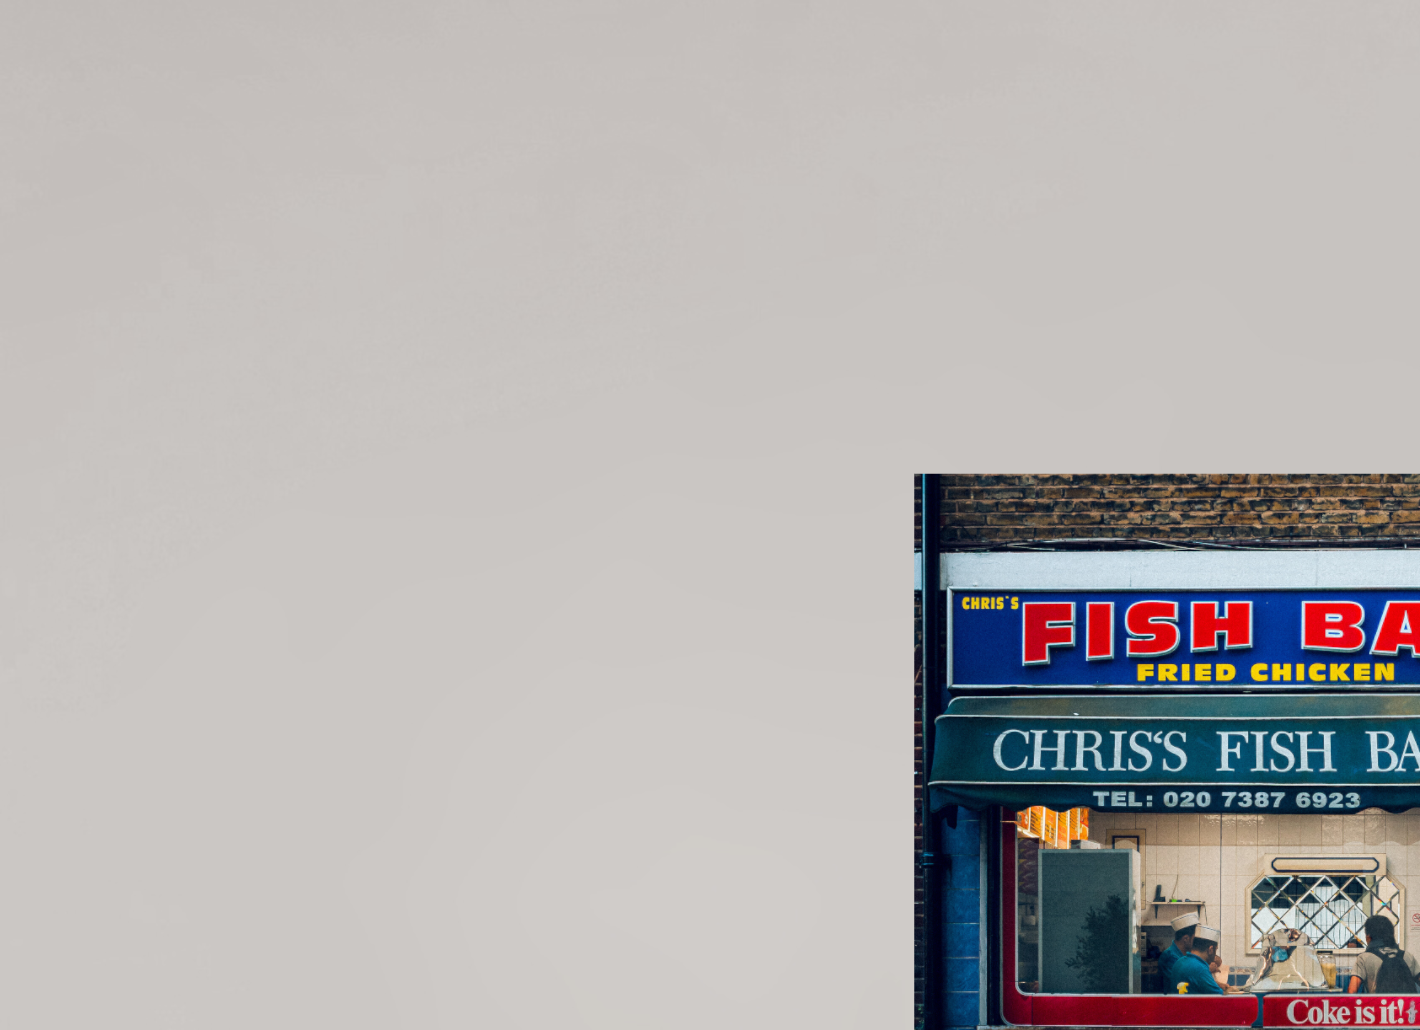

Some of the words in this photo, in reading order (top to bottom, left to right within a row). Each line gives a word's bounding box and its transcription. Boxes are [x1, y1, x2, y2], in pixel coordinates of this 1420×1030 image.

[1021, 600, 1253, 667] FISH
[1136, 662, 1236, 682] FRIED
[1250, 662, 1396, 682] CHICKEN
[1215, 729, 1337, 772] FISH
[1092, 791, 1153, 807] TEL:
[1163, 791, 1211, 808] 020
[1221, 791, 1286, 808] 7387
[1295, 791, 1361, 808] 6923
[1286, 998, 1351, 1025] Coke
[1354, 998, 1375, 1025] is
[1379, 998, 1405, 1025] it!
